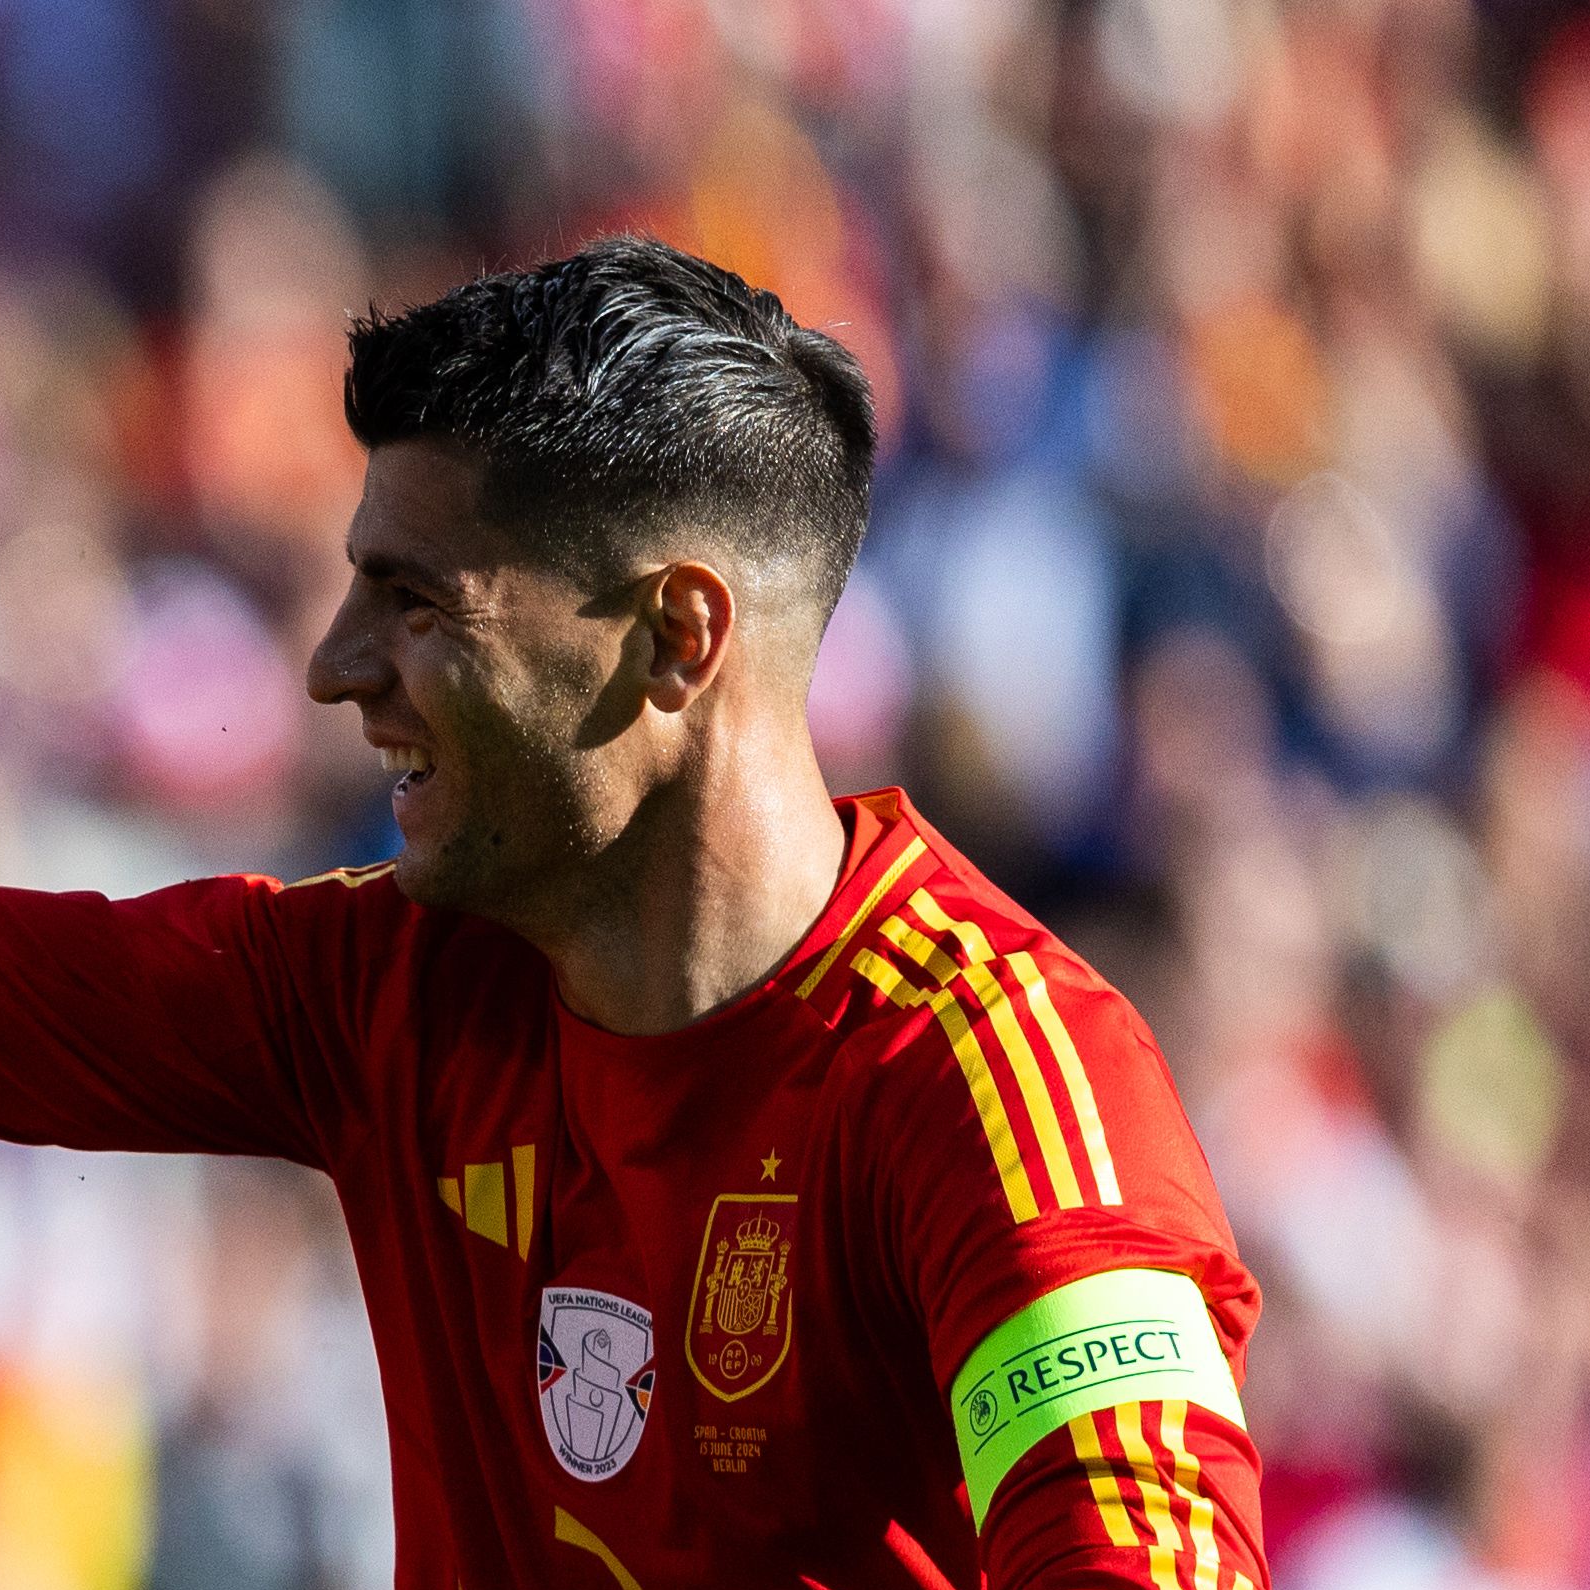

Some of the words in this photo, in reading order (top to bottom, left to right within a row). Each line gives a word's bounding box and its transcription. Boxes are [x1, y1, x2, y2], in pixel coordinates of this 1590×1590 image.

[548, 1294, 573, 1305] UEFA
[575, 1295, 619, 1312] NATIONS
[1007, 1331, 1182, 1405] RESPECT
[694, 1424, 718, 1439] SPAIN
[729, 1426, 767, 1441] CROATIA
[710, 1441, 733, 1457] JUNE
[736, 1443, 761, 1457] 2024
[558, 1443, 592, 1474] WINNER
[594, 1458, 617, 1475] 2023
[712, 1459, 747, 1473] BERLIN
